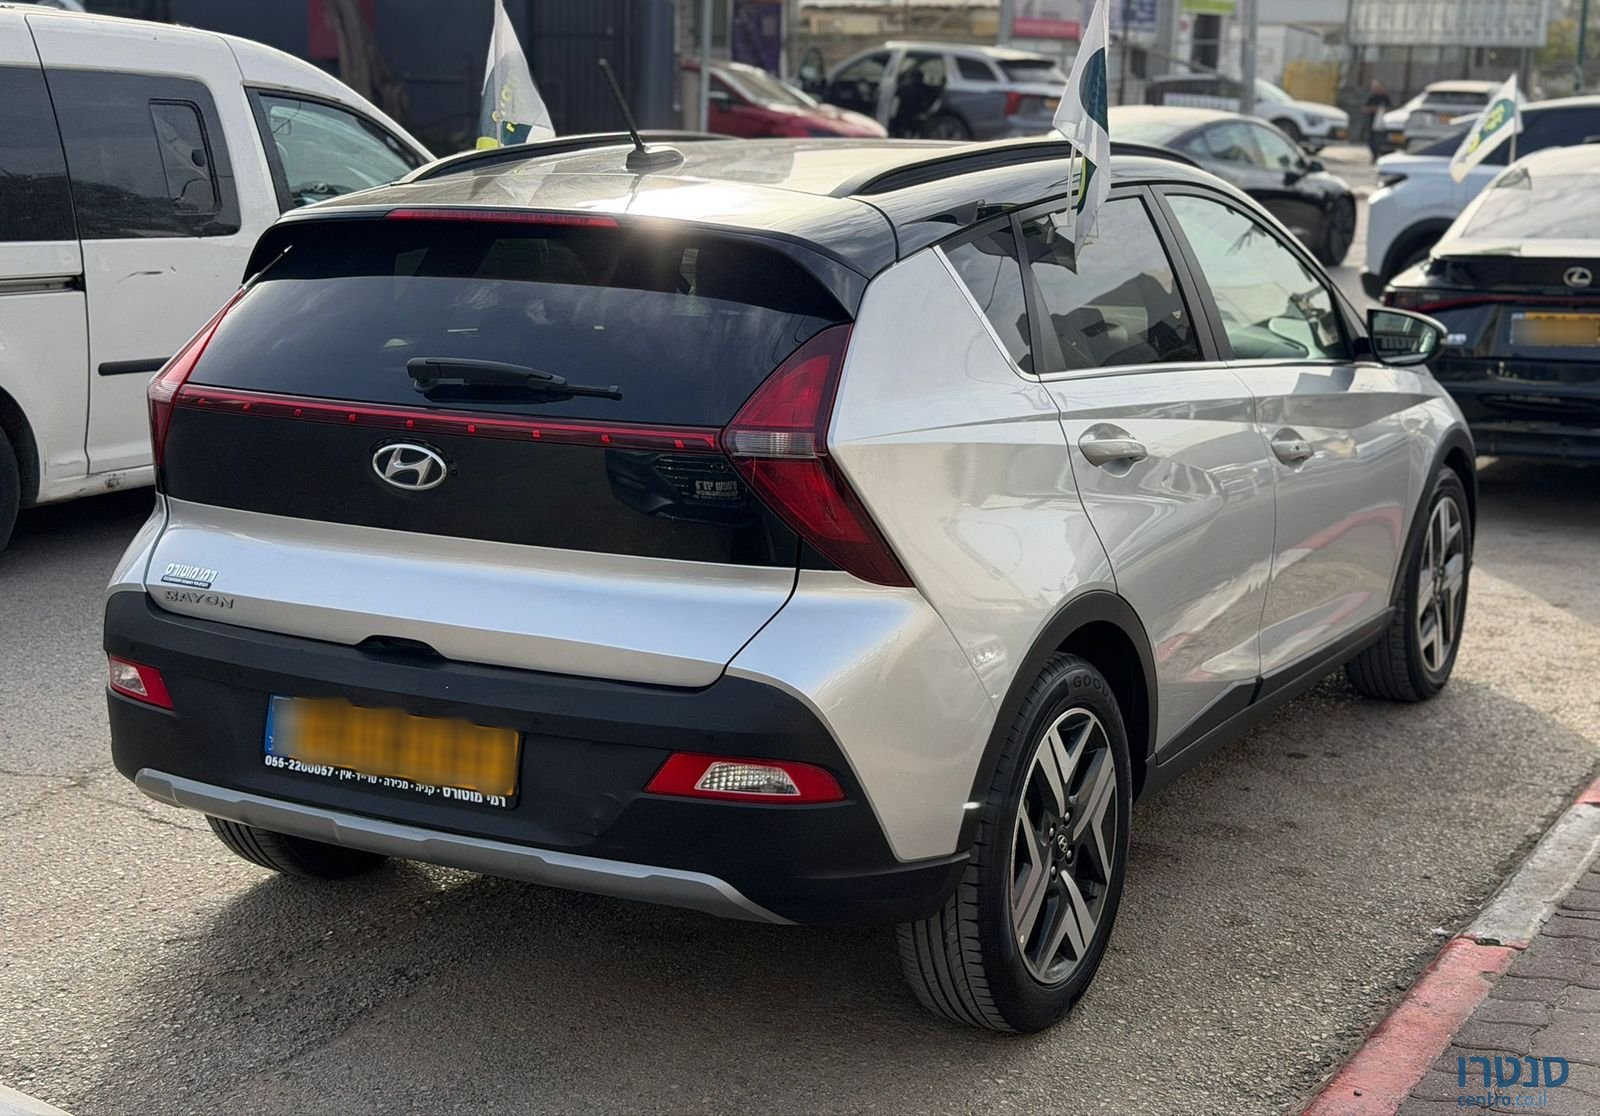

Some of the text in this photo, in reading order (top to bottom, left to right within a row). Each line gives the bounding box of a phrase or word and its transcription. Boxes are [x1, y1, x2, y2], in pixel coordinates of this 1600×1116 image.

[264, 755, 334, 777] 055-2200057
[383, 777, 409, 790] מכירה
[415, 783, 435, 796] קניה
[442, 786, 483, 803] מוטורס
[486, 794, 506, 808] רמי
